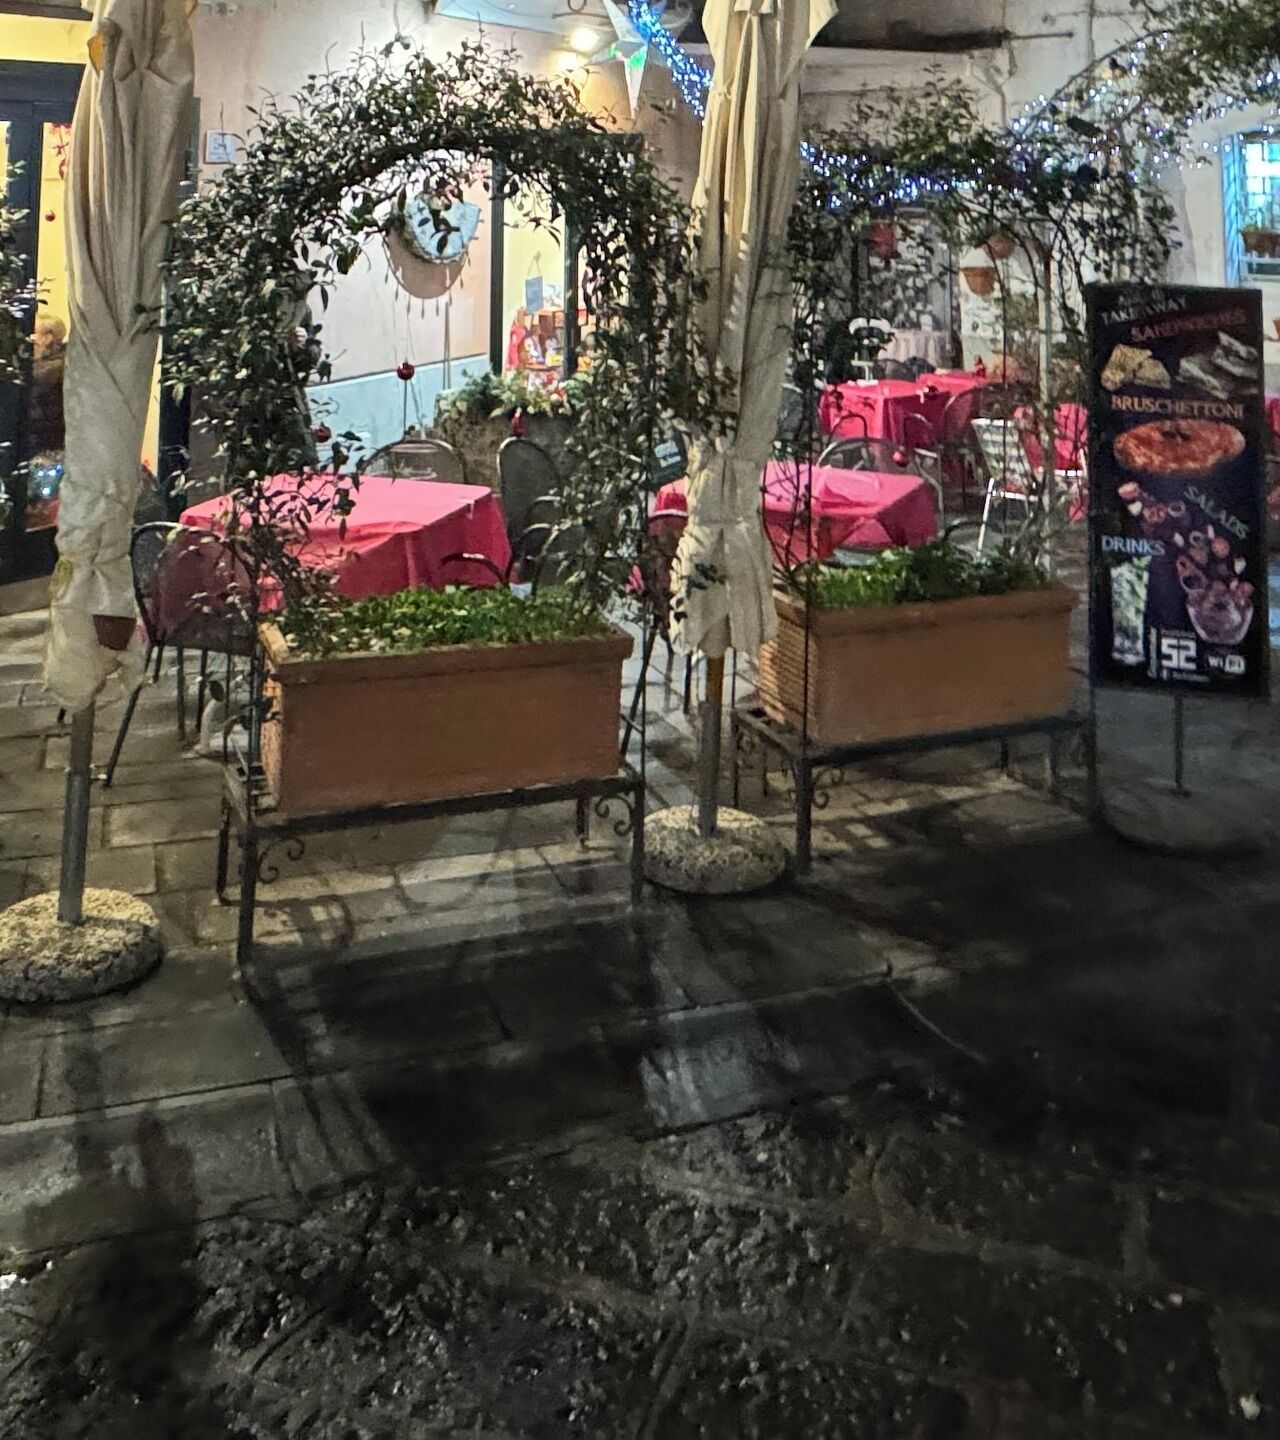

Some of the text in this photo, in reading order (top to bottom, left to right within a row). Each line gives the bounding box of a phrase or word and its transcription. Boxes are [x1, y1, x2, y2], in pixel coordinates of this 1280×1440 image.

[1111, 394, 1245, 419] BRUSCHETTONI
[1183, 485, 1250, 540] SALADS
[1101, 534, 1166, 556] DRINKS
